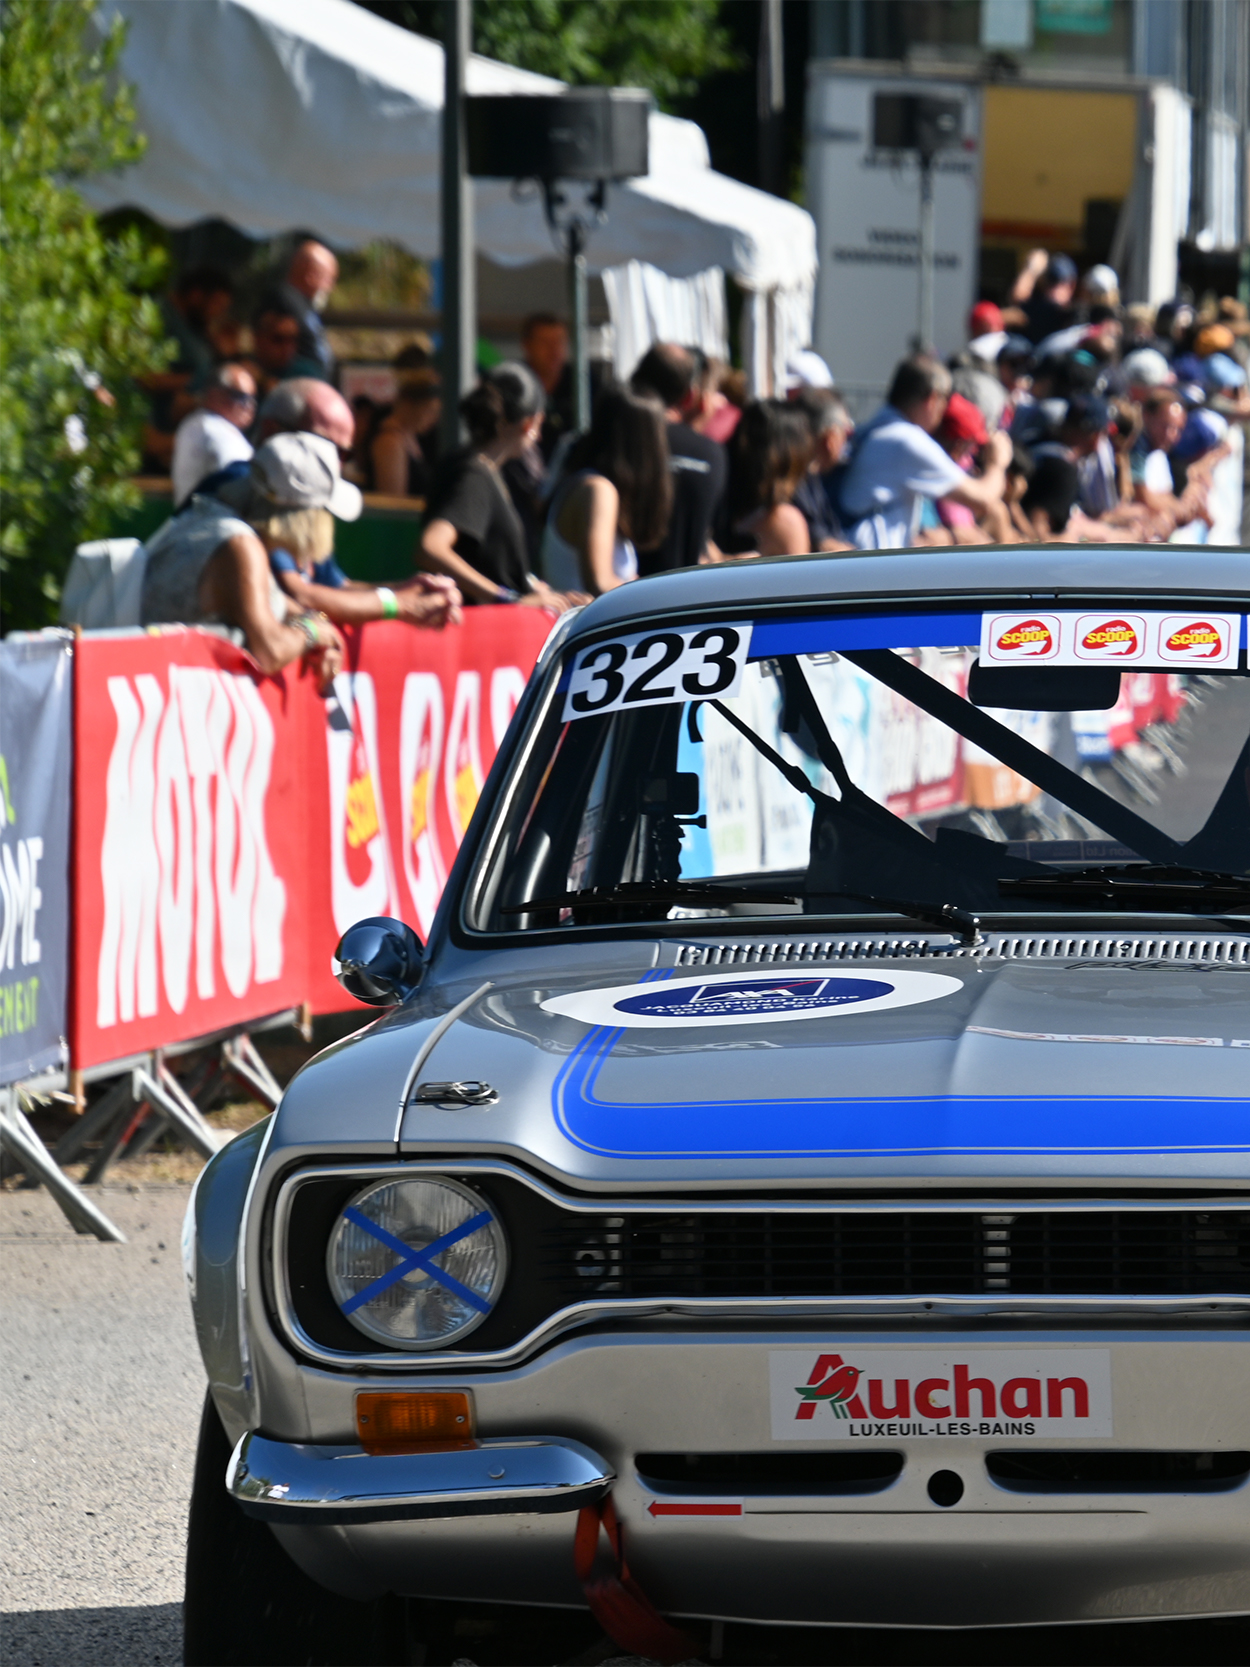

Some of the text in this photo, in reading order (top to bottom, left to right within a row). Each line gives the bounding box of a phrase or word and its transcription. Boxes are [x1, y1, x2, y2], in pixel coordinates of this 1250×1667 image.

[1020, 625, 1041, 633] radio
[1105, 625, 1127, 633] radio
[1001, 630, 1050, 644] SCOOP
[1086, 630, 1135, 644] SCOOP
[1170, 632, 1220, 646] SCOOP
[571, 627, 740, 712] 323
[97, 663, 287, 1029] MOTUL
[794, 1354, 1089, 1419] Auchan
[849, 1422, 1036, 1436] LUXEUIL-LES-BAINS
